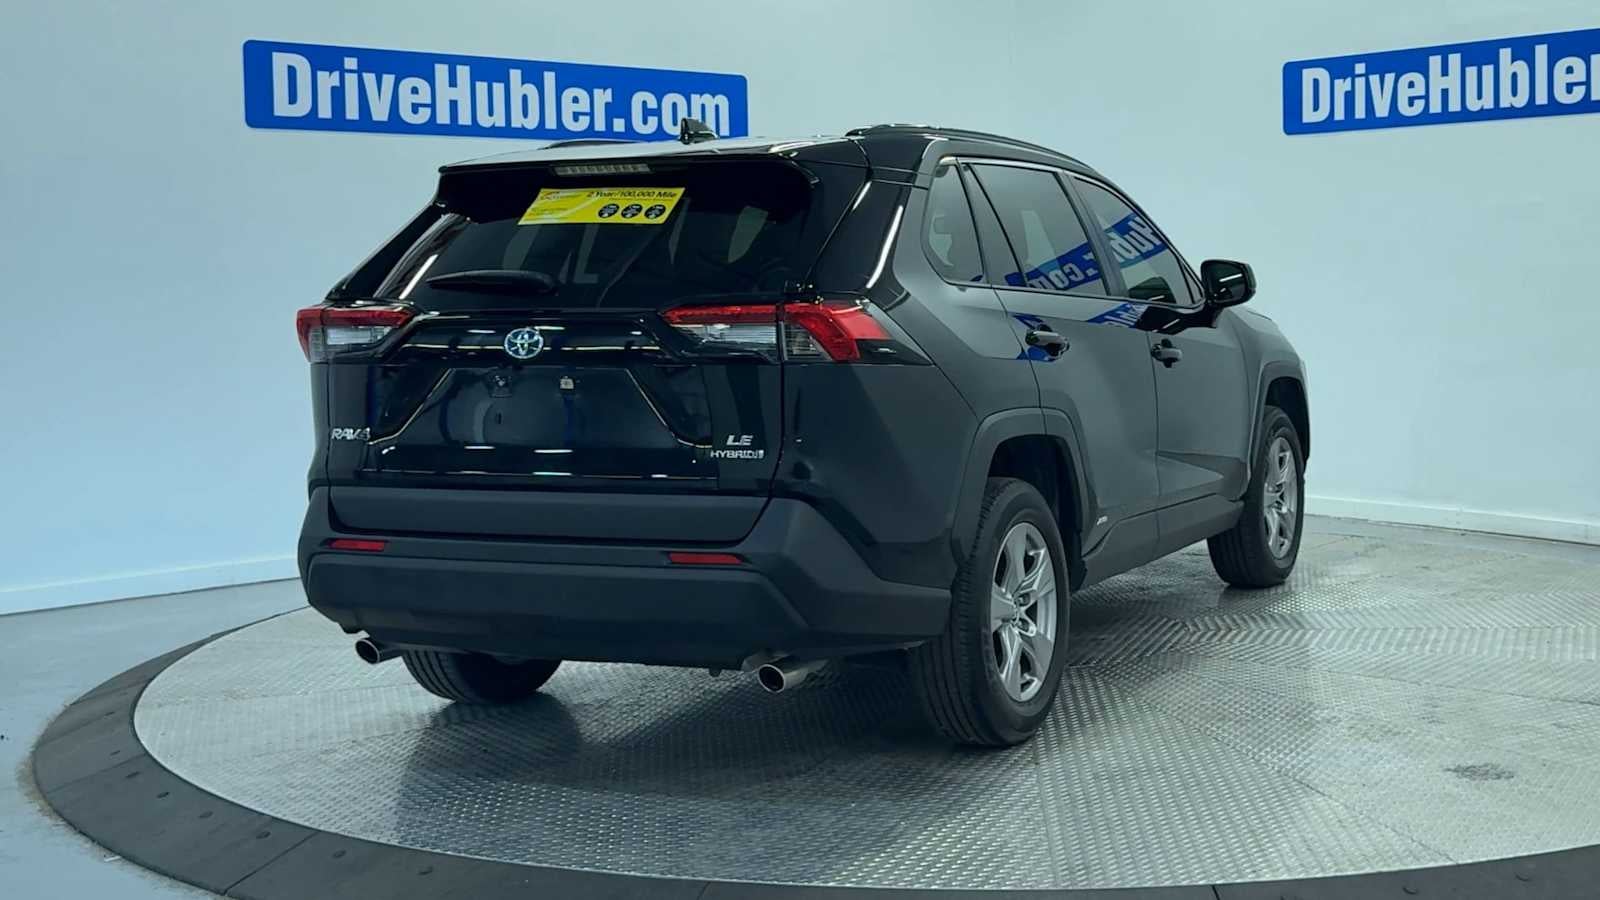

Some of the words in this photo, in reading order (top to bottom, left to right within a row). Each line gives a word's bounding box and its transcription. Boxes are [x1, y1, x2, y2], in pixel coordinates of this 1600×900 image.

[271, 51, 730, 136] DriveHubler.com
[331, 427, 371, 440] RAV4
[726, 434, 754, 446] LE
[710, 449, 756, 459] HYBRID
